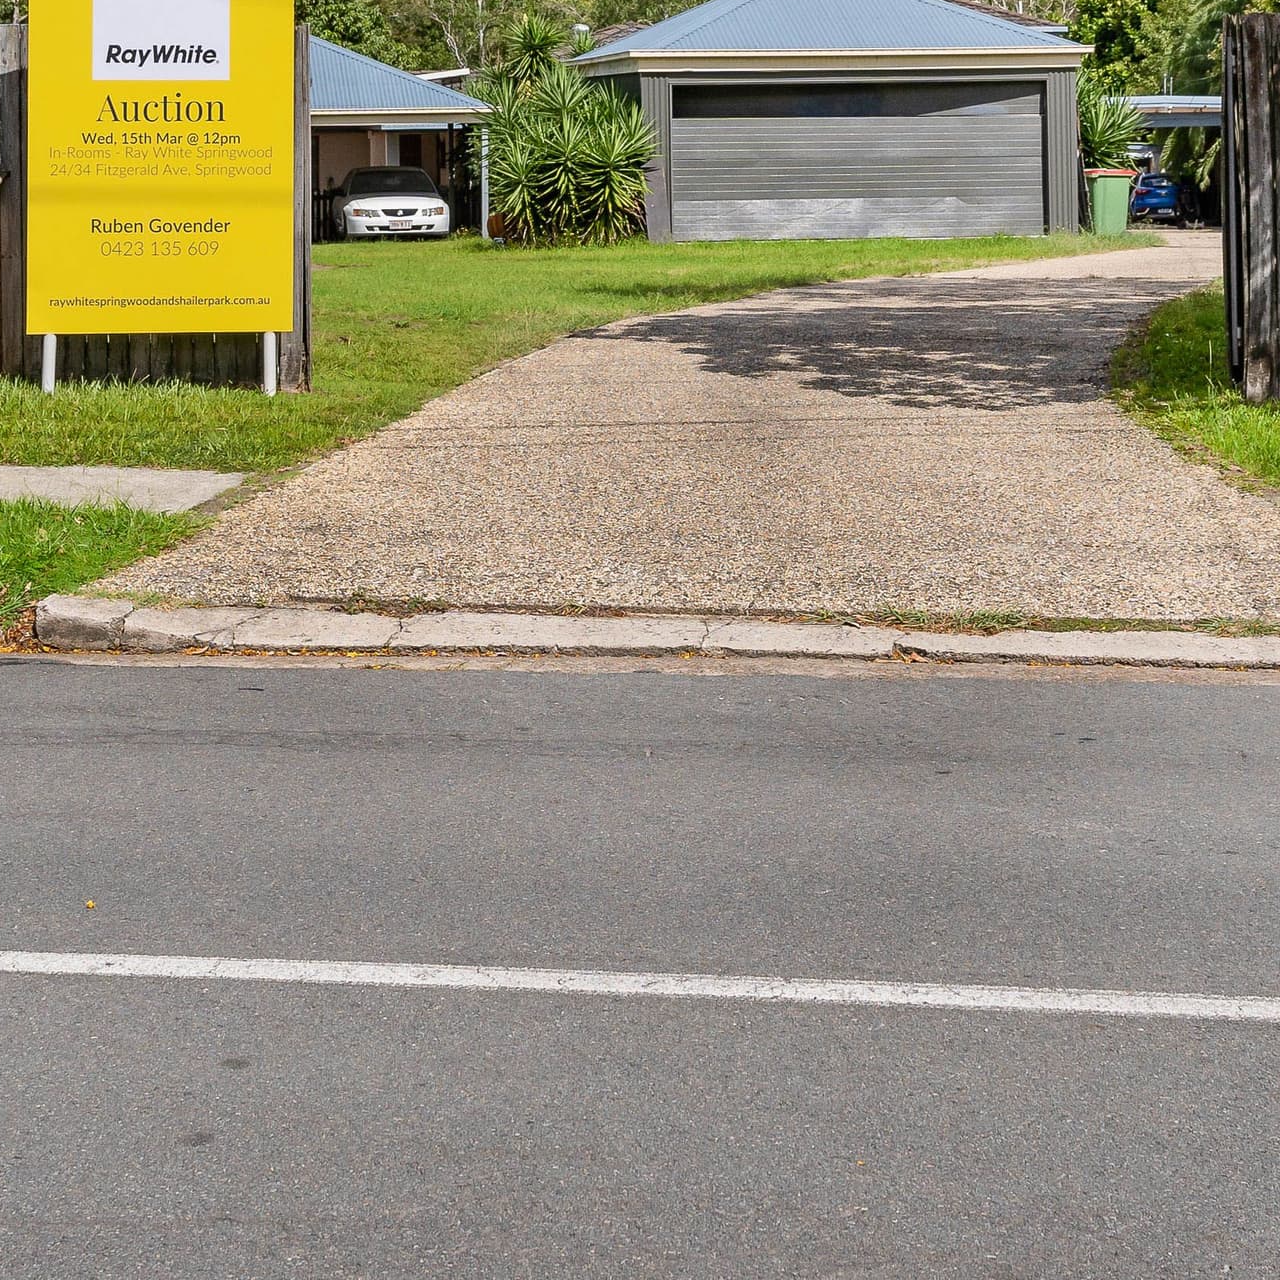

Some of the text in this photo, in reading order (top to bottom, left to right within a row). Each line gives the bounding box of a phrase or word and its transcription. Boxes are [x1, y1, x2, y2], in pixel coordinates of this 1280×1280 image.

[96, 92, 226, 123] Auction
[122, 132, 152, 145] 15th
[156, 132, 183, 145] Mar
[187, 132, 199, 146] @
[203, 131, 241, 147] 12pm
[49, 146, 111, 159] In-Rooms
[125, 146, 148, 160] Ray
[152, 145, 192, 159] White
[196, 145, 273, 161] Springwood
[50, 163, 91, 177] 24/34
[95, 163, 158, 179] Fitzgerald
[195, 162, 272, 178] Springwood
[91, 218, 231, 234] Ruben Govender
[100, 240, 219, 256] 0423 135 609
[49, 295, 271, 309] raywhitespringwoodandshailerpark.com.au
